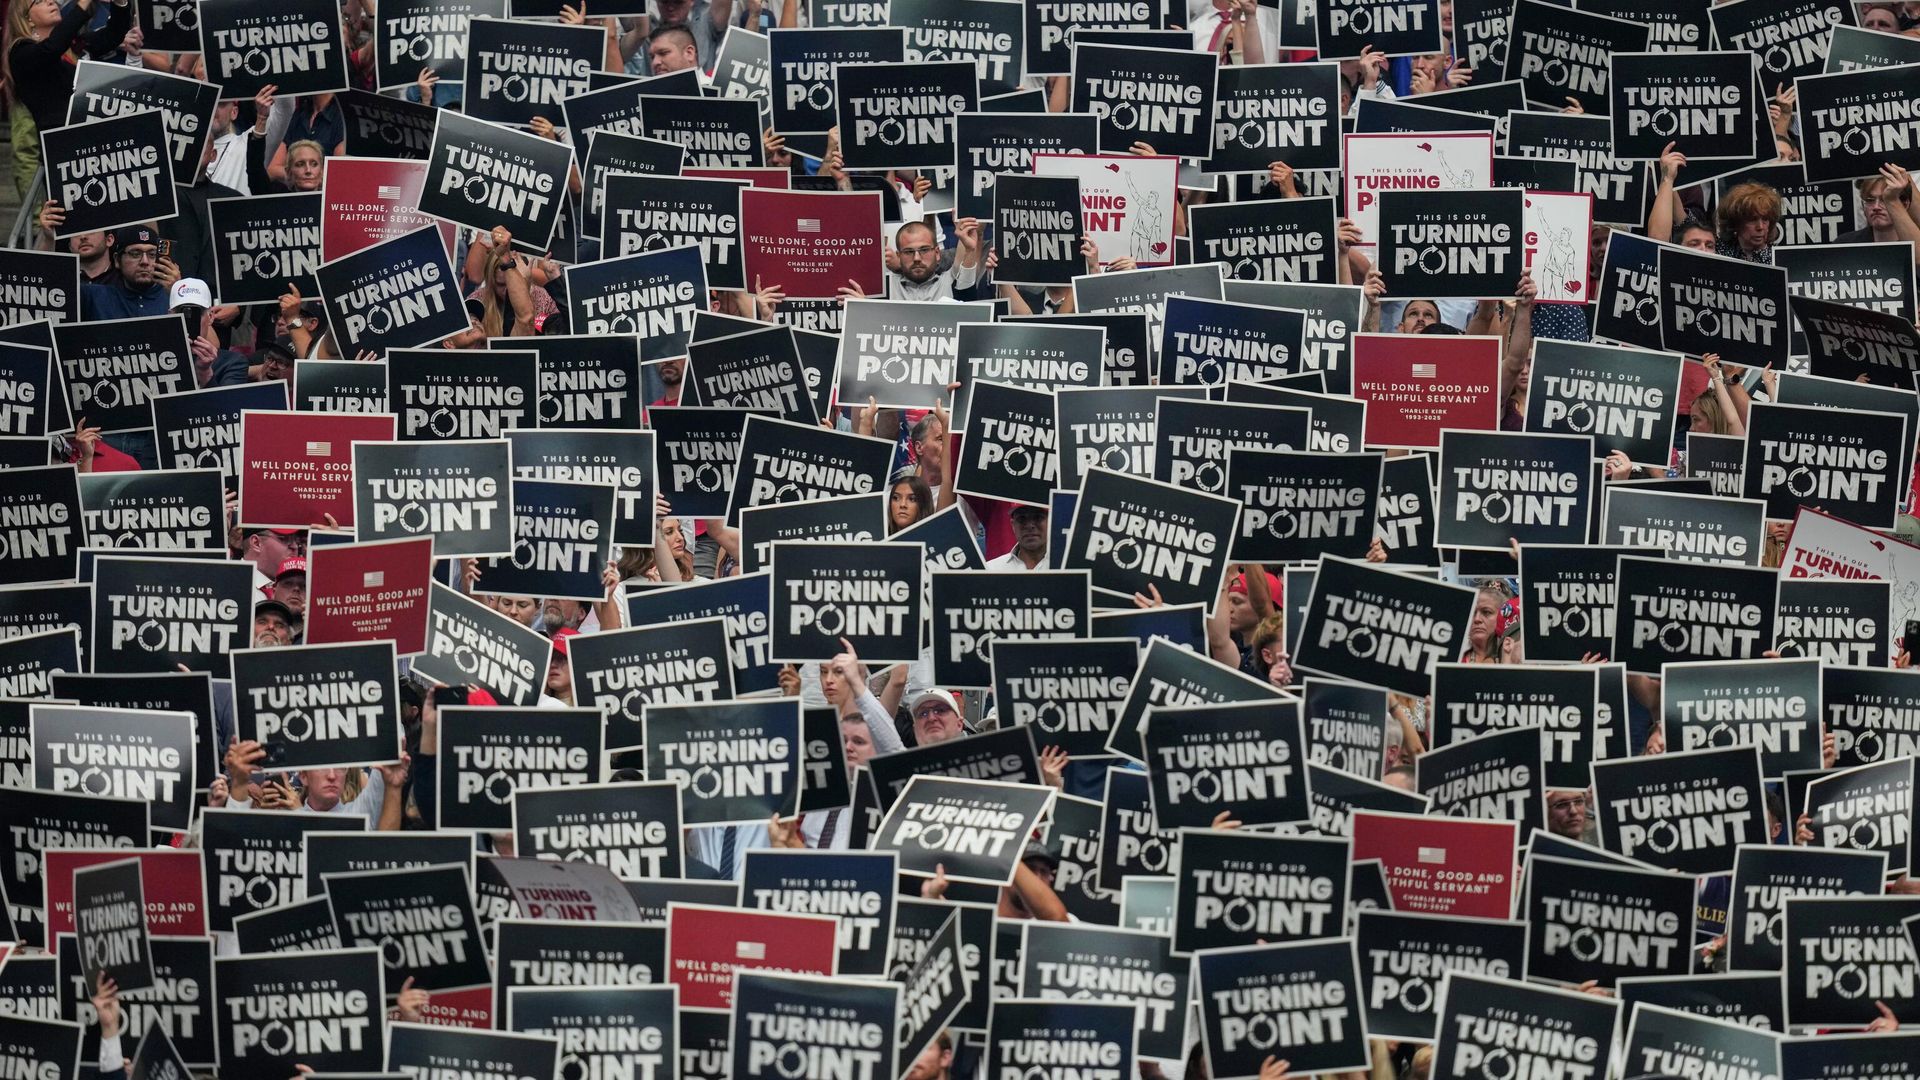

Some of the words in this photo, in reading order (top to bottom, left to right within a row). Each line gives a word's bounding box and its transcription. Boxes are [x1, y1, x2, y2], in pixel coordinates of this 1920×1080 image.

[214, 22, 328, 49] TURNING
[236, 18, 260, 26] THIS
[220, 42, 330, 78] POINT
[1112, 70, 1135, 78] THIS
[1086, 78, 1202, 104] TURNING
[1624, 86, 1740, 106] TURNING
[1214, 97, 1326, 119] TURNING
[1629, 107, 1741, 136] POINT
[76, 146, 97, 156] THIS
[116, 139, 134, 148] OUR
[1216, 119, 1327, 149] POINT
[57, 146, 157, 181] TURNING
[446, 144, 553, 193] TURNING
[62, 167, 160, 211] POINT
[439, 172, 549, 222] POINT
[1354, 176, 1440, 189] TURNING
[617, 209, 736, 234] TURNING
[1001, 208, 1073, 230] TURNING
[750, 236, 774, 244] WELL
[778, 238, 810, 246] DONE,
[1003, 230, 1075, 260] POINT
[1204, 232, 1323, 258] TURNING
[1391, 224, 1510, 244] TURNING
[761, 246, 808, 255] FAITHFUL
[812, 248, 861, 256] SERVANT
[1395, 245, 1511, 275] POINT
[582, 281, 694, 318] TURNING
[1670, 283, 1776, 317] TURNING
[1676, 305, 1777, 346] POINT
[63, 351, 178, 379] TURNING
[968, 358, 1088, 381] TURNING
[1570, 368, 1595, 377] THIS
[1618, 374, 1640, 382] OUR
[1361, 382, 1387, 391] WELL
[1392, 384, 1424, 393] DONE,
[1429, 384, 1461, 393] GOOD
[1372, 393, 1422, 402] FAITHFUL
[1427, 395, 1477, 403] SERVANT
[1544, 376, 1663, 408] TURNING
[1543, 400, 1661, 440] POINT
[1788, 432, 1815, 441] THIS
[1840, 436, 1863, 444] OUR
[252, 461, 279, 469] WELL
[284, 462, 319, 471] DONE,
[324, 463, 352, 471] GOO
[1481, 458, 1507, 466] THIS
[1760, 440, 1887, 470] TURNING
[264, 472, 317, 481] FAITHFUL
[368, 477, 497, 500] TURNING
[1268, 476, 1295, 484] THIS
[1454, 468, 1578, 493] TURNING
[1761, 464, 1886, 502] POINT
[1241, 485, 1365, 508] TURNING
[1456, 491, 1577, 526] POINT
[85, 506, 210, 530] TURNING
[374, 500, 497, 533] POINT
[1092, 506, 1216, 554] TURNING
[1243, 508, 1364, 539] POINT
[1085, 530, 1212, 586] POINT
[812, 569, 839, 577] THIS
[136, 585, 163, 593] THIS
[189, 587, 212, 595] OUR
[316, 596, 341, 606] WELL
[345, 594, 374, 604] DONE,
[378, 590, 403, 601] GOOD
[406, 588, 423, 597] AND
[786, 580, 909, 602] TURNING
[108, 595, 238, 620] TURNING
[326, 605, 372, 616] FAITHFUL
[376, 600, 414, 612] SERVANT
[790, 603, 909, 636] POINT
[945, 608, 1075, 630] TURNING
[1631, 595, 1761, 626] TURNING
[112, 618, 238, 654] POINT
[433, 609, 535, 680] TURNING
[1633, 620, 1760, 659] POINT
[275, 674, 304, 683] THIS
[330, 671, 354, 680] OUR
[249, 680, 382, 710] TURNING
[75, 733, 103, 741] THIS
[255, 705, 384, 743] POINT
[686, 730, 715, 739] THIS
[739, 728, 763, 737] OUR
[48, 743, 180, 768] TURNING
[660, 737, 788, 765] TURNING
[1158, 740, 1290, 769] TURNING
[54, 766, 180, 802] POINT
[1167, 765, 1292, 803] POINT
[1611, 786, 1748, 822] TURNING
[530, 821, 666, 850] TURNING
[1619, 810, 1751, 857] POINT
[1193, 870, 1332, 900] TURNING
[1195, 896, 1332, 935] POINT
[1542, 897, 1678, 934] TURNING
[1696, 905, 1726, 924] RLIE
[1544, 923, 1677, 968] POINT
[1037, 962, 1175, 996] TURNING
[226, 990, 368, 1020] TURNING
[1213, 981, 1345, 1015] TURNING
[234, 1017, 369, 1056] POINT
[1221, 1007, 1348, 1051] POINT
[1456, 1014, 1597, 1061] TURNING
